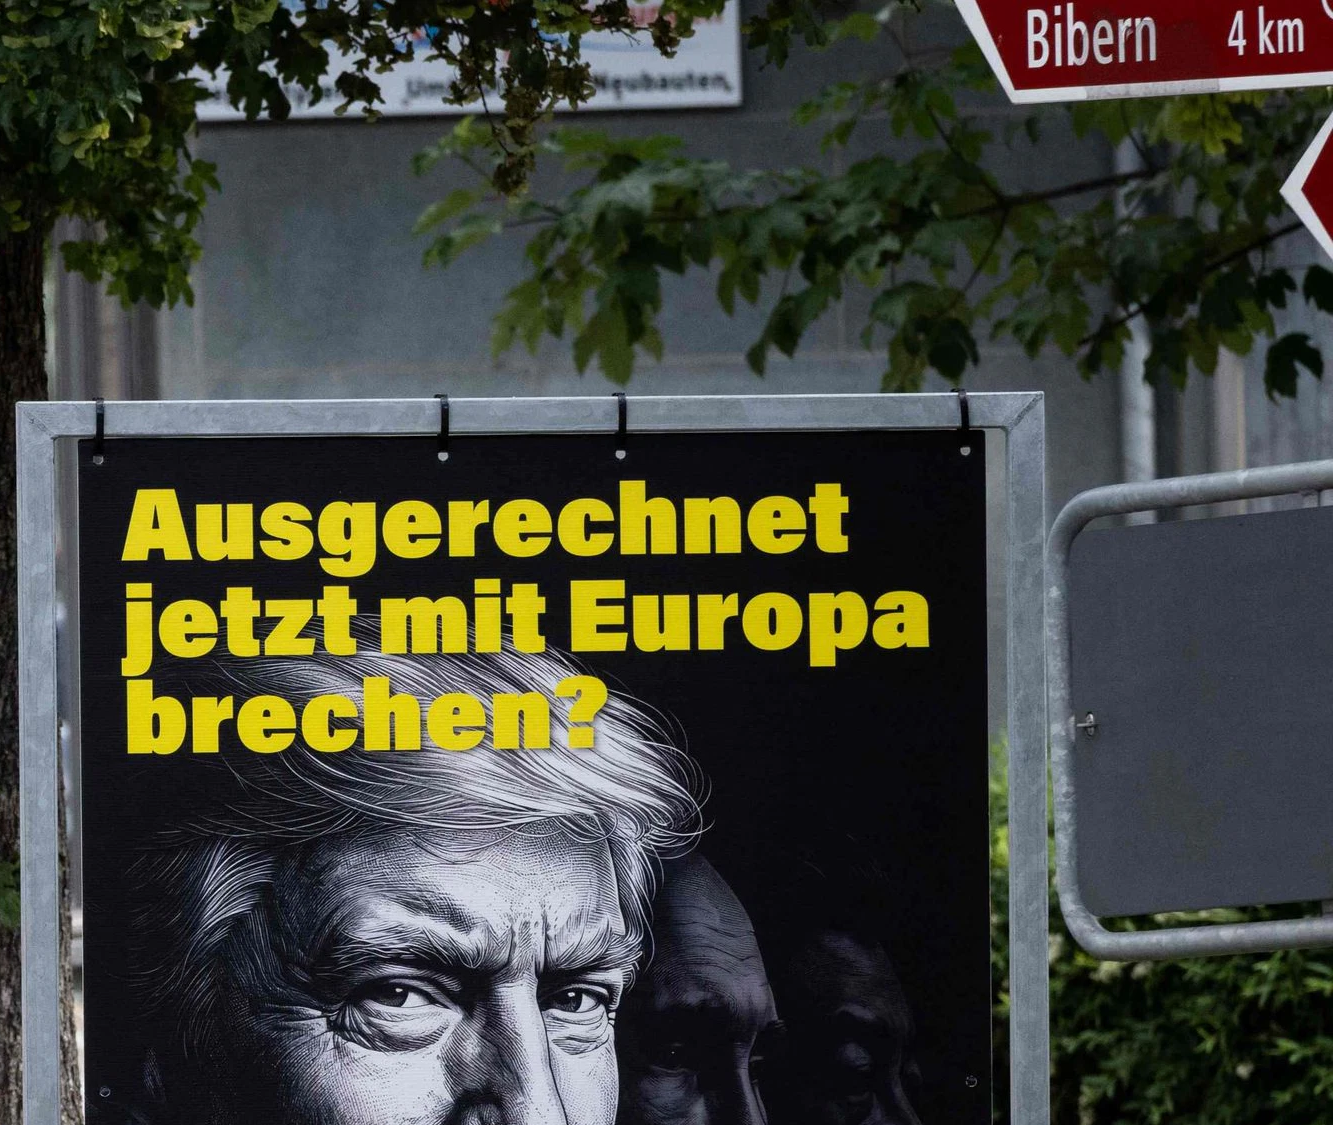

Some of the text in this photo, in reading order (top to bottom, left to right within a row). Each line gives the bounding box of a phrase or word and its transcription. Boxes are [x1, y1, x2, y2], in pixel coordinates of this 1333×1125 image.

[1027, 2, 1305, 69] Bibern 4 km
[121, 480, 850, 578] Ausgerechnet
[121, 578, 931, 677] jetzt mit Europa
[126, 675, 610, 755] brechen?
